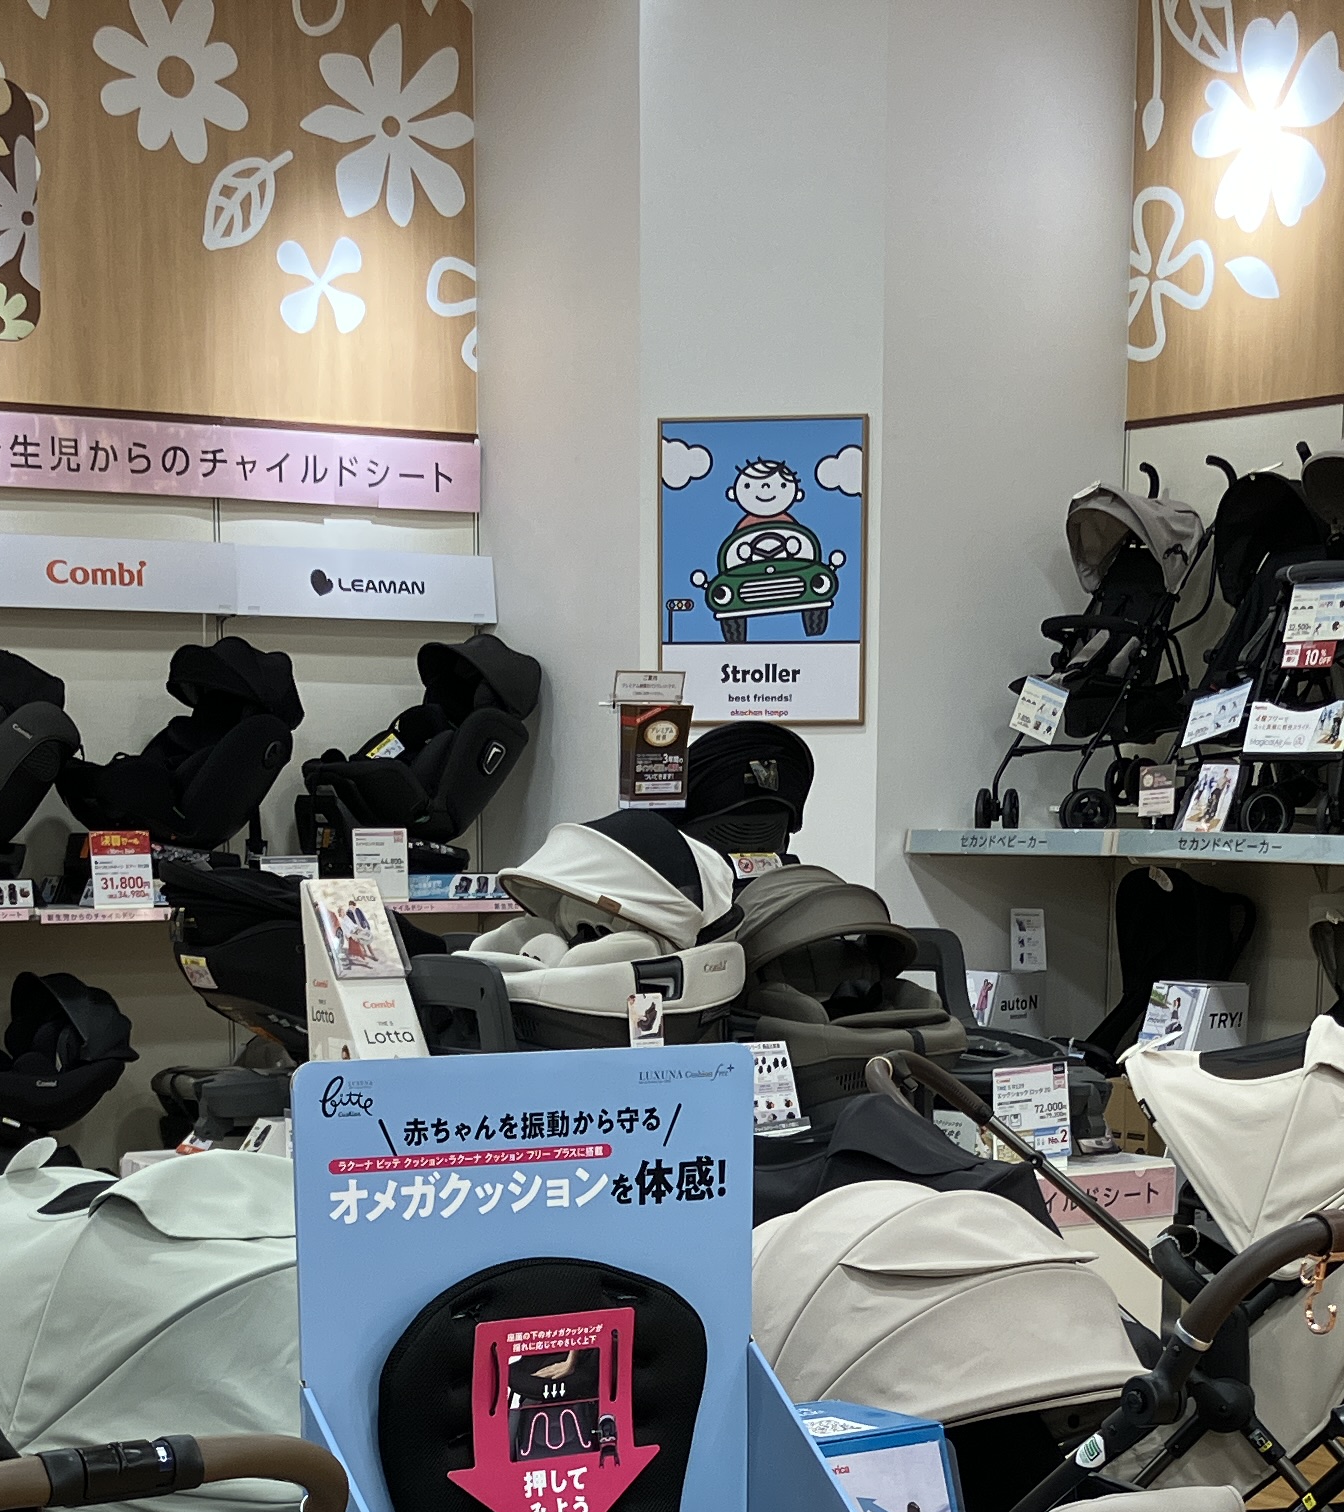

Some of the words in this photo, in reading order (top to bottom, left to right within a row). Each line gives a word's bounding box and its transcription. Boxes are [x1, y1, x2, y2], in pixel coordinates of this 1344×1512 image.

[46, 559, 147, 589] Combi
[338, 575, 425, 595] LEAMAN
[720, 663, 801, 684] Stroller
[728, 694, 750, 703] best
[753, 693, 793, 704] friends!
[960, 835, 1048, 848] セカンドベビーカー
[1177, 838, 1283, 852] セカンドベビーカー
[100, 875, 152, 892] 31,800円
[362, 1000, 396, 1010] Combi
[311, 1006, 335, 1025] Lotta
[1208, 1011, 1244, 1029] TRY!
[364, 1028, 416, 1046] Lotta
[638, 1069, 684, 1083] LUXUNA
[402, 1106, 663, 1147] 赤ちゃんを振動から守る
[328, 1156, 727, 1226] オメガクッションを体感!
[523, 1466, 588, 1499] 押して
